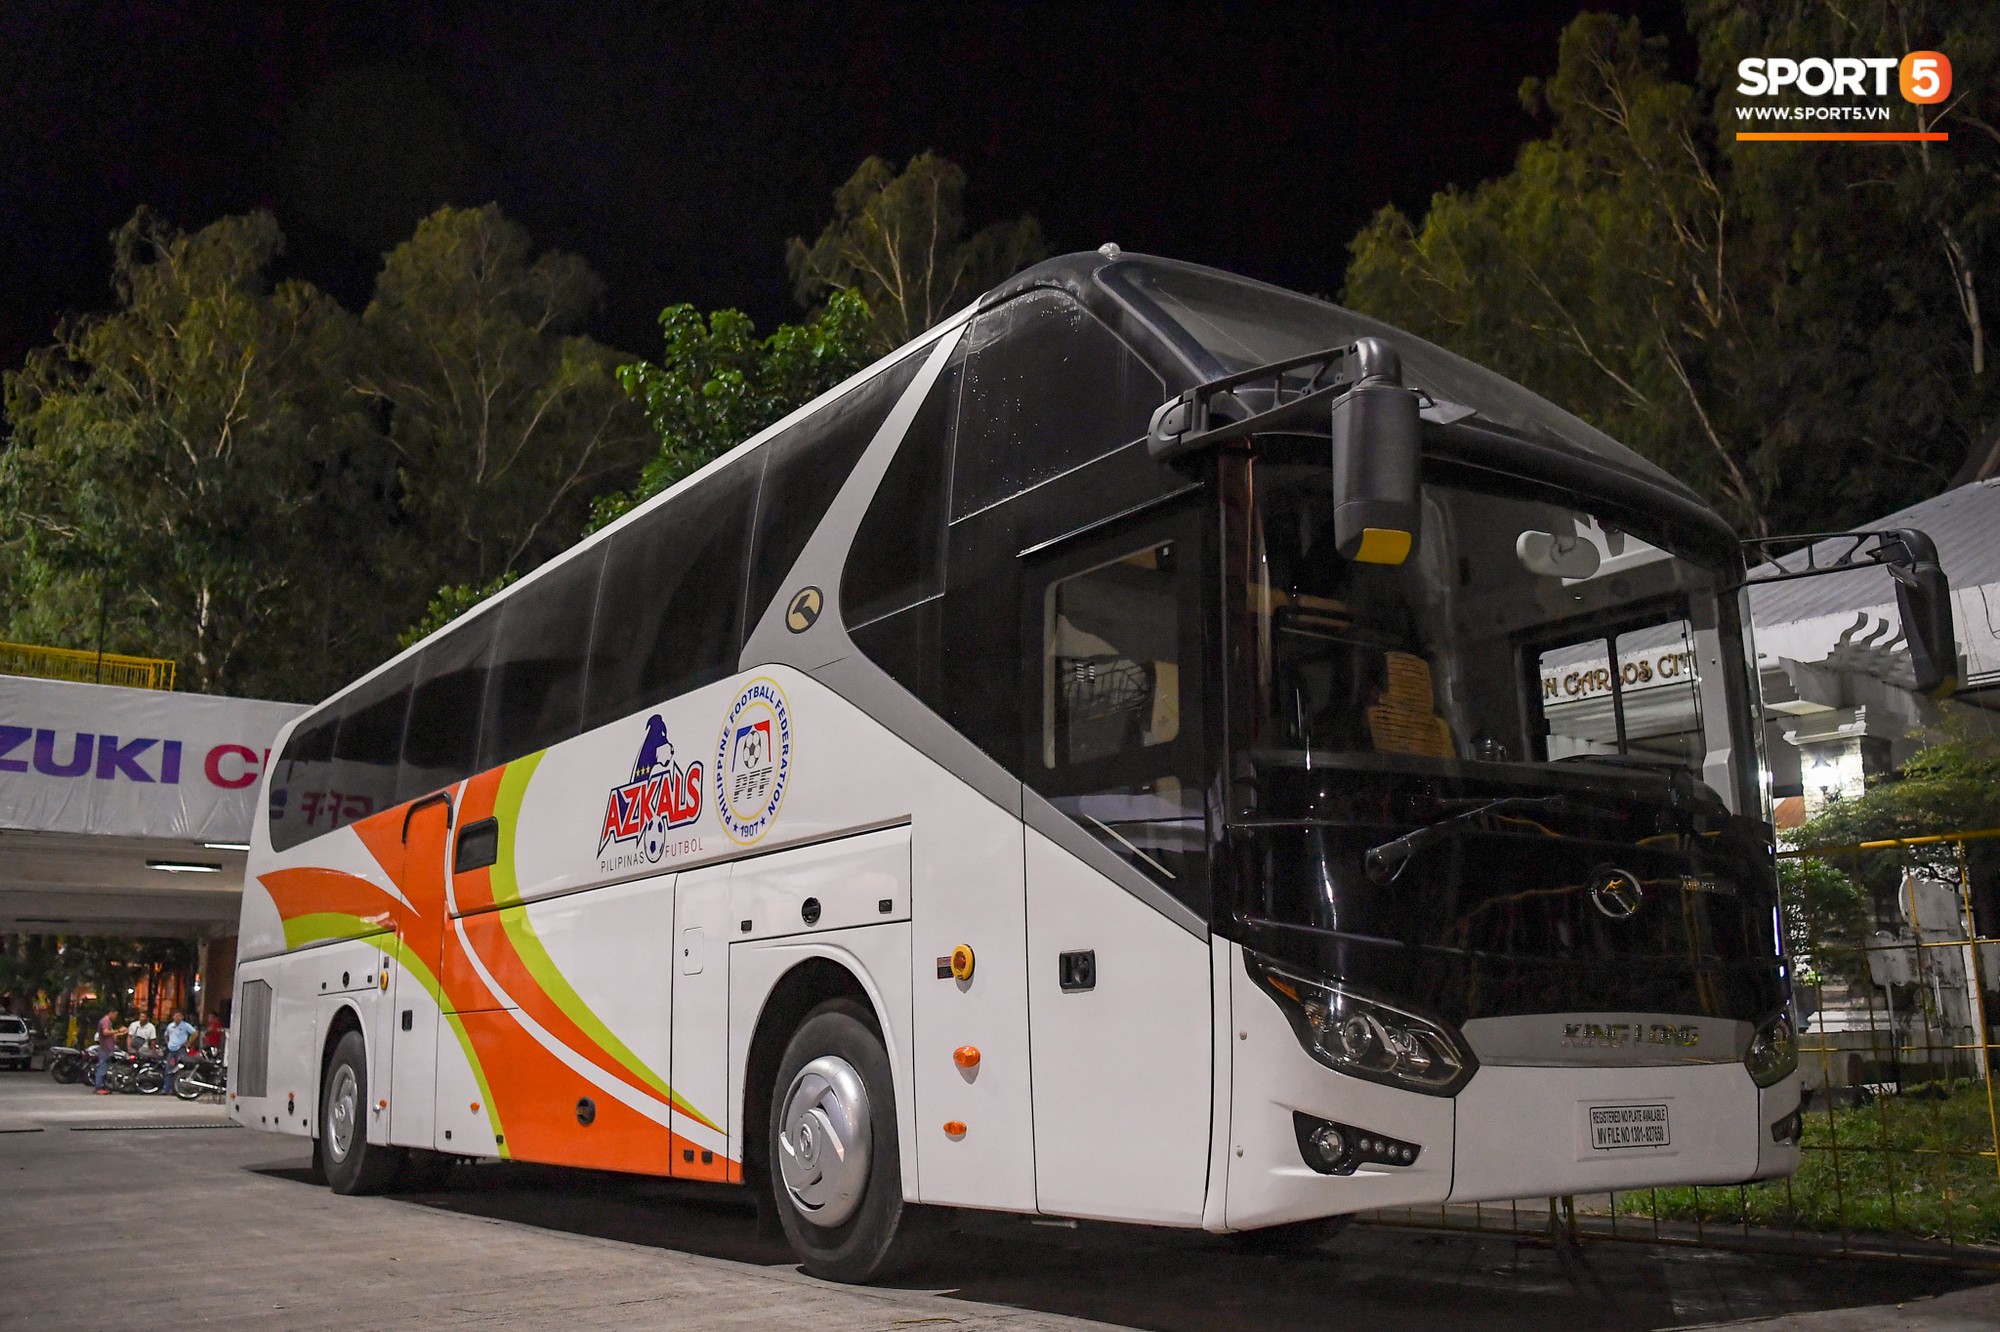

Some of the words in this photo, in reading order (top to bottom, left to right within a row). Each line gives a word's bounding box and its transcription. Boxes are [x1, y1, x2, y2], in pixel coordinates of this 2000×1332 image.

[1563, 660, 1653, 696] CAROS
[204, 744, 272, 789] C
[716, 726, 732, 826] PHILIPPINE
[729, 685, 775, 724] FOOTBALL
[767, 699, 789, 817] FEDERATION
[602, 766, 702, 842] AZKALS
[740, 821, 759, 838] 1907
[601, 851, 645, 873] PILIPINAS
[665, 837, 703, 858] FUTBOL
[1592, 1110, 1620, 1124] REGISTERED
[1621, 1110, 1628, 1123] NO
[1628, 1109, 1642, 1122] PLATE
[1643, 1108, 1666, 1122] AVAILABLE
[1607, 1126, 1620, 1143] FILE
[1621, 1126, 1630, 1143] NO
